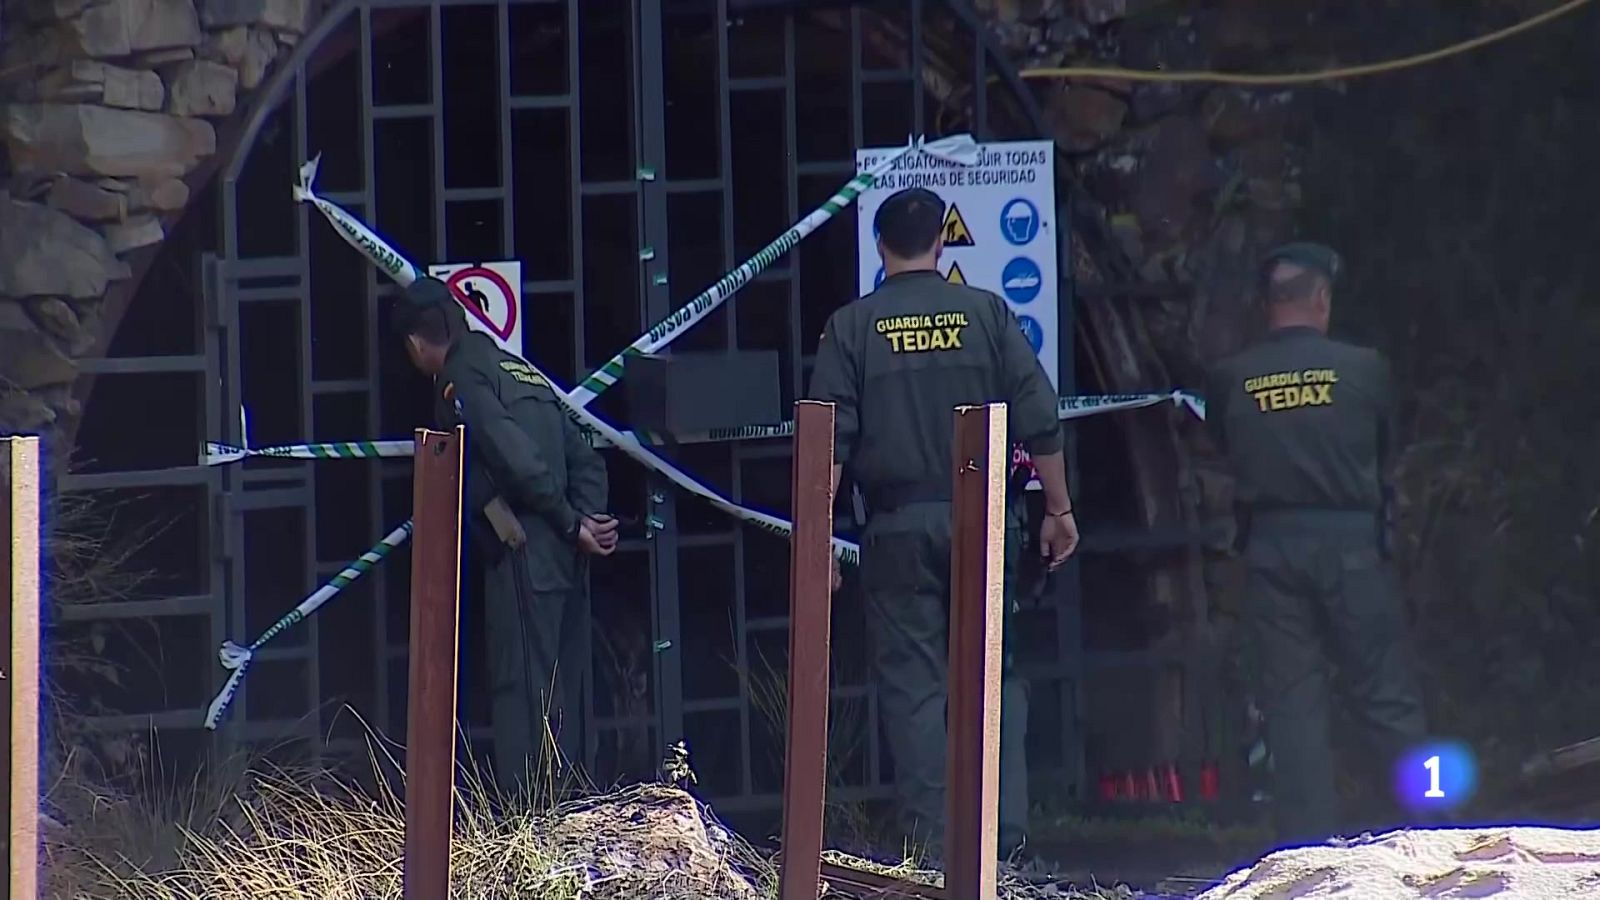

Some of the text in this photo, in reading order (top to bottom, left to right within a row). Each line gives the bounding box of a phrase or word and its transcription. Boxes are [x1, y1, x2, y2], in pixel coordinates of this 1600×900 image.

[1005, 150, 1046, 166] TODAS
[873, 168, 1037, 190] LAS NORMAS DE SEGURIDAD
[650, 306, 692, 344] PASAR
[876, 312, 969, 332] GUARDIA CIVIL
[886, 327, 963, 352] TEDAX
[1244, 369, 1340, 393] GUARDIA CIVIL
[1254, 383, 1333, 412] TEDAX
